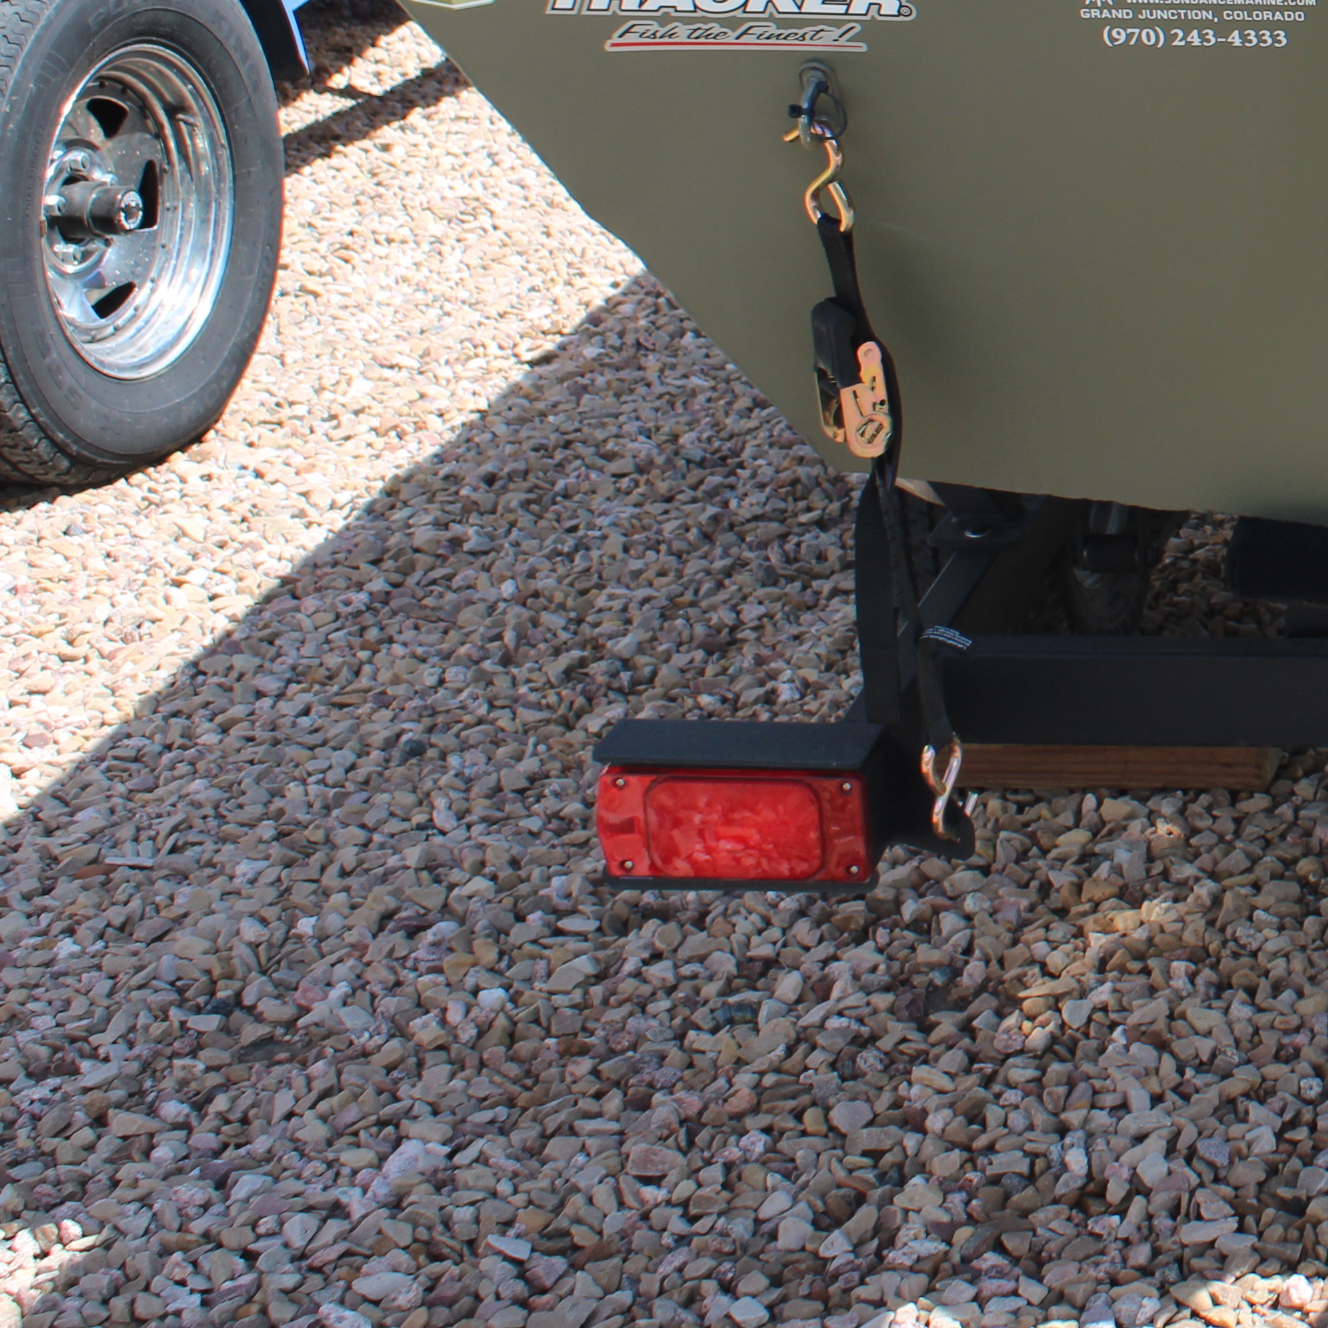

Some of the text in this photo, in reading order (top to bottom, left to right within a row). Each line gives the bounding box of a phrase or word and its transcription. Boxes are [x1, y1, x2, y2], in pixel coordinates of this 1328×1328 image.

[1080, 8, 1305, 23] GRAND JUNCTION, COLORADO
[617, 21, 678, 42] Fish
[684, 22, 730, 42] the
[735, 23, 826, 43] Finest
[1102, 25, 1288, 48] (970) 243-4333
